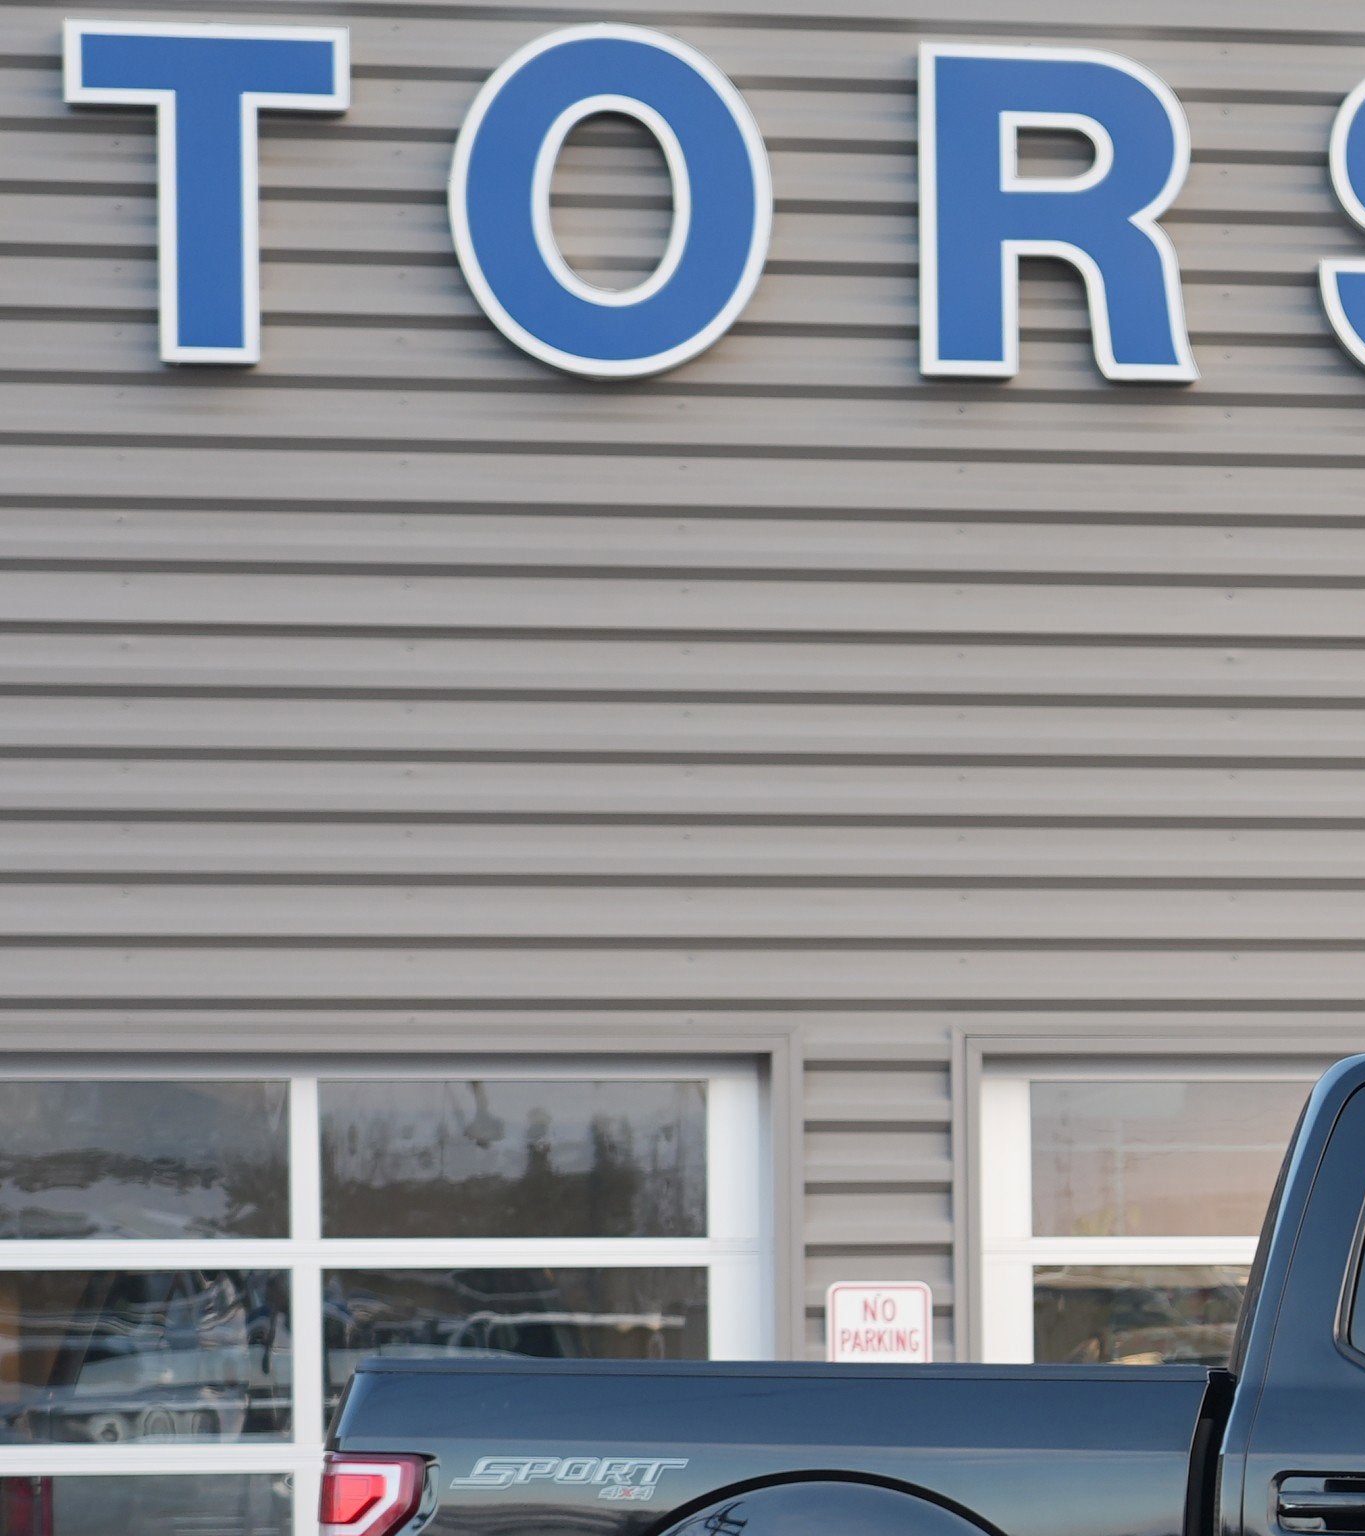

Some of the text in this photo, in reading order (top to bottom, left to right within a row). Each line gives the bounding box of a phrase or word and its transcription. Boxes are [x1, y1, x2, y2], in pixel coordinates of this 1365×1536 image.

[862, 1297, 896, 1322] NO
[840, 1327, 919, 1352] PARKING
[450, 1456, 689, 1490] SPORT
